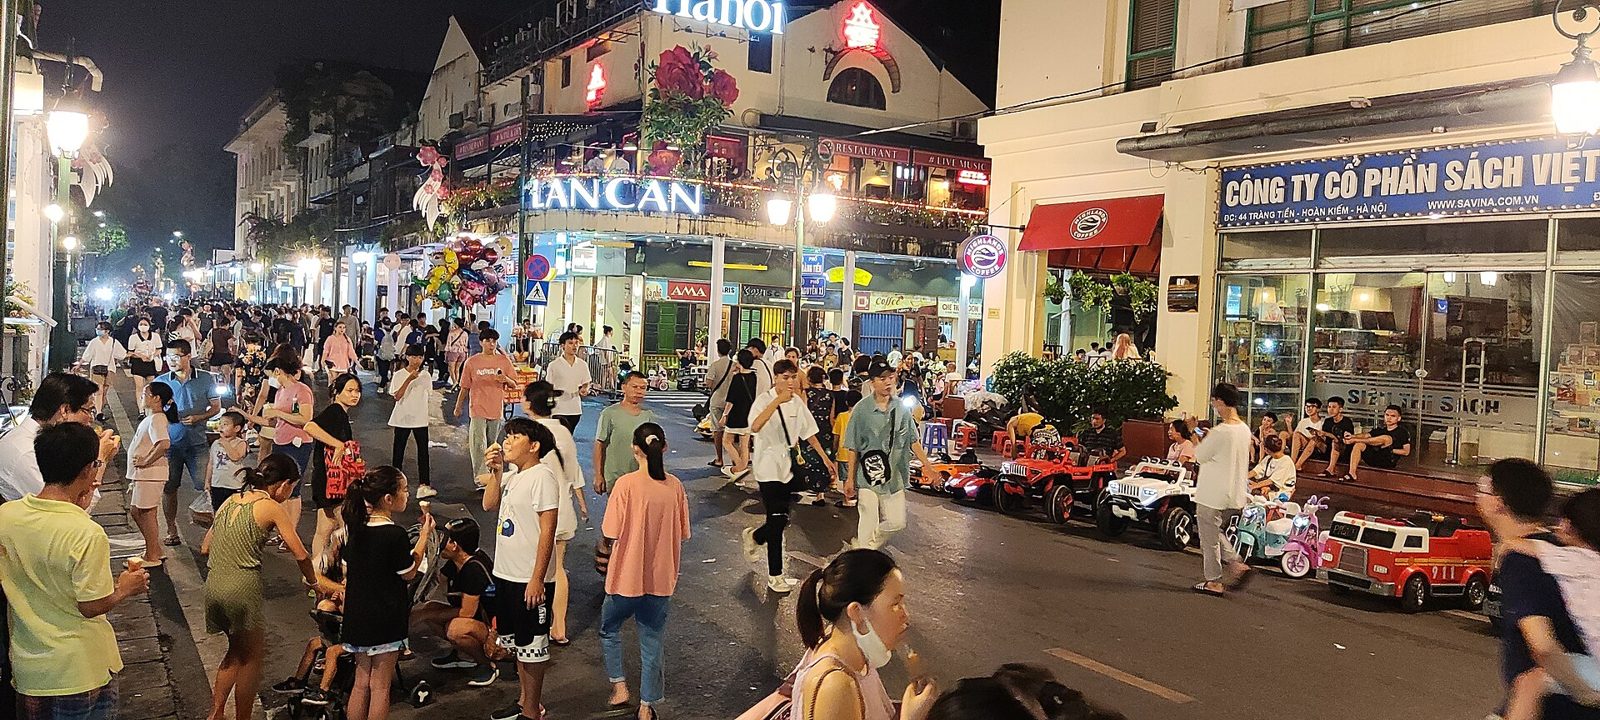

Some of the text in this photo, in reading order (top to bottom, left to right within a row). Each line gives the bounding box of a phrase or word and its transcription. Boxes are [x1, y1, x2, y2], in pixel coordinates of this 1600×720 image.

[835, 144, 897, 159] RESTAURANT
[959, 159, 986, 170] MUSIC
[1225, 144, 1600, 207] CÔNG TY CỔ PHẦN SÁCH VIỆT
[1428, 195, 1539, 210] WWW.SAVINA.COM.VN
[1238, 212, 1248, 221] 44
[1248, 209, 1276, 220] TRÀNG
[1301, 206, 1326, 217] HOÀN
[1327, 203, 1349, 215] KIẾM
[1356, 203, 1369, 214] HÀ
[1370, 202, 1387, 214] NỘI
[1073, 229, 1098, 238] COFFEE
[970, 265, 1000, 276] COFFEE
[671, 286, 707, 297] AMA
[875, 296, 901, 306] Coffee
[1432, 565, 1455, 579] 911
